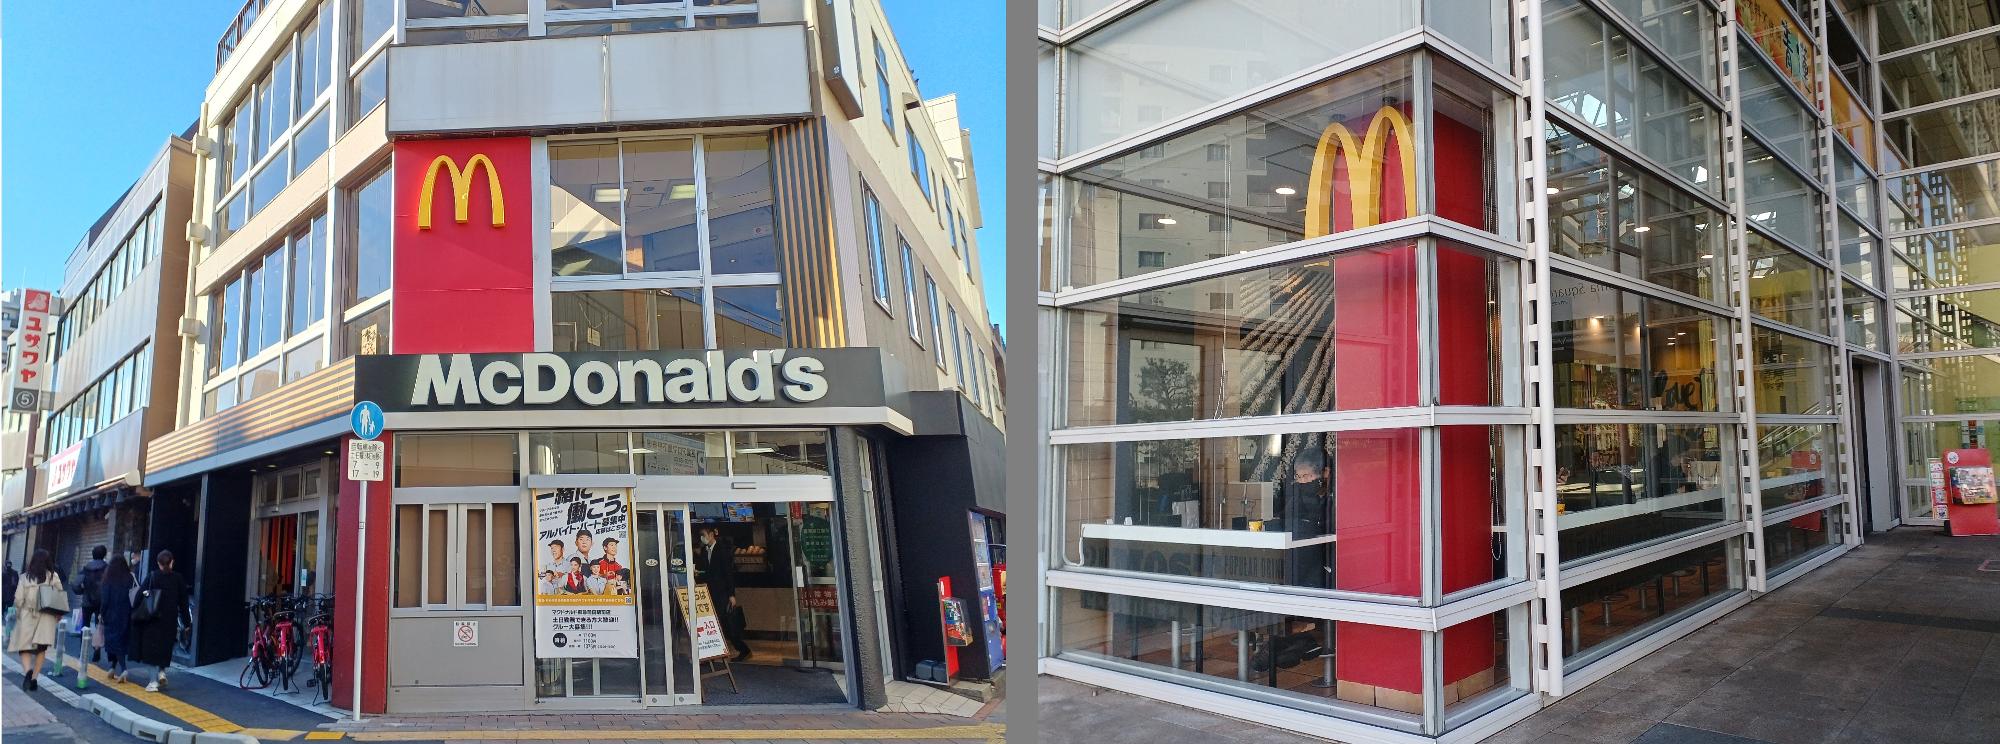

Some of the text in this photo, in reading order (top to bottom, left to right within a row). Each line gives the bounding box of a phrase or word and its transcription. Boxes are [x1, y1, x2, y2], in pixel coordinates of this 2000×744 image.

[411, 350, 829, 407] McDonald's
[376, 461, 380, 469] 9
[352, 470, 360, 478] 17
[681, 590, 706, 601] こらは
